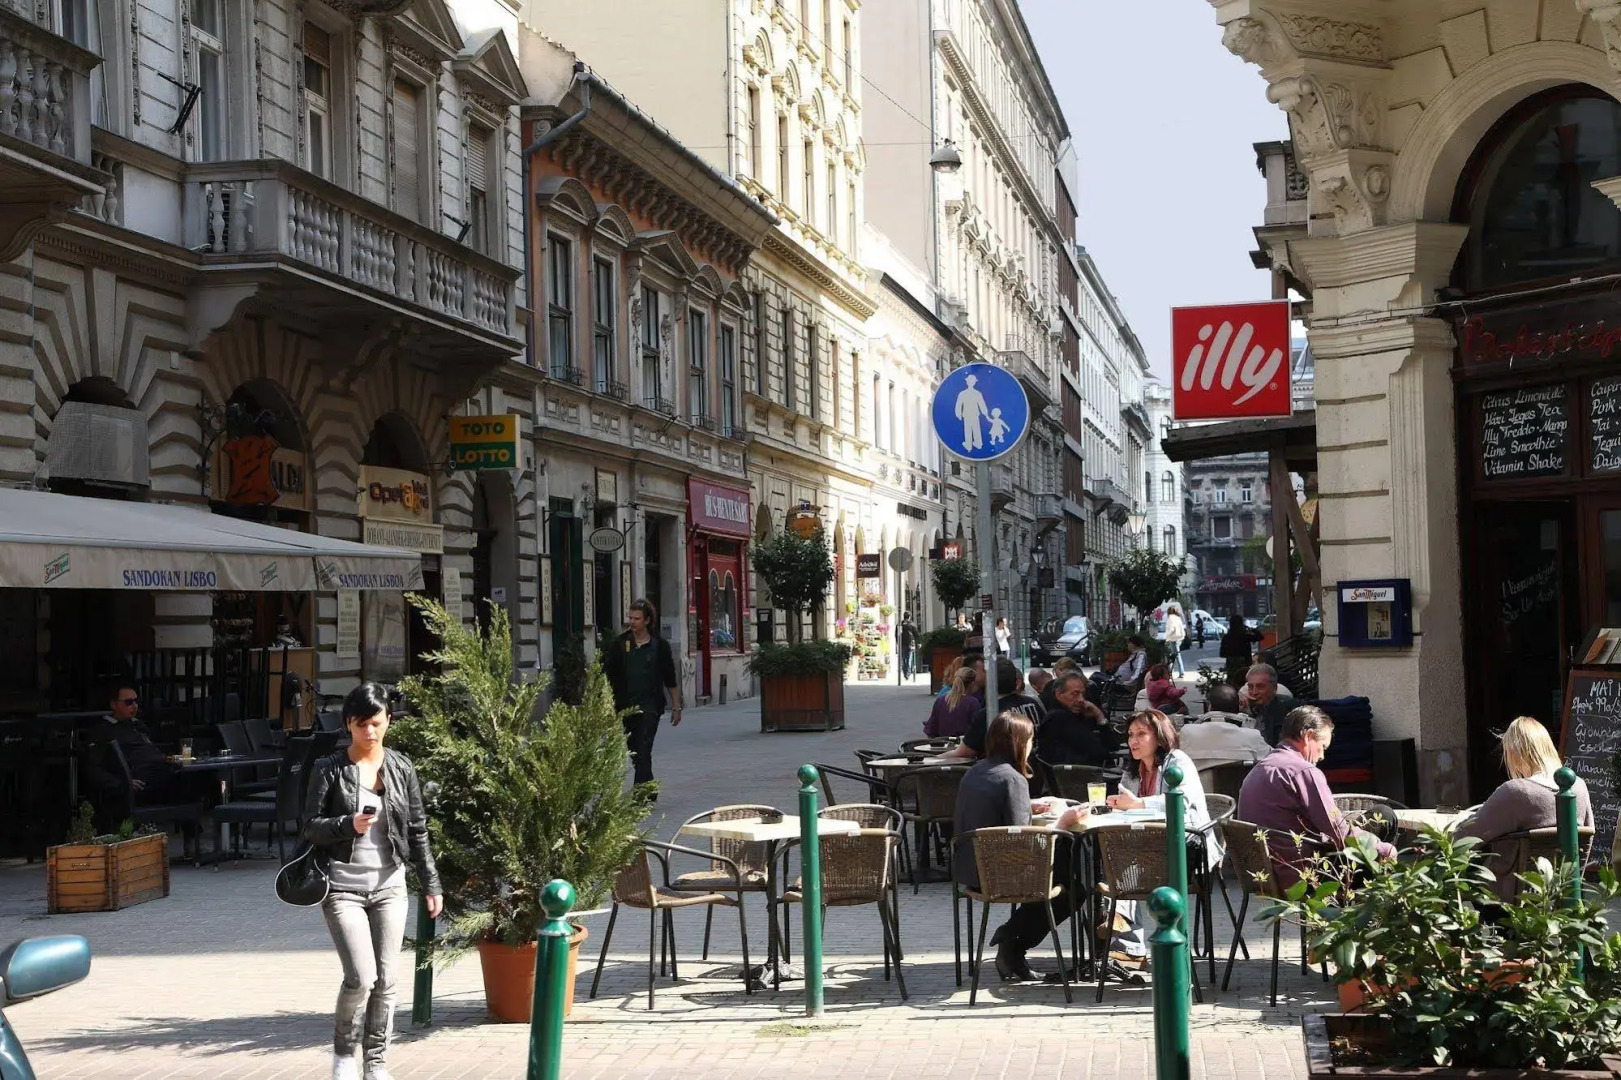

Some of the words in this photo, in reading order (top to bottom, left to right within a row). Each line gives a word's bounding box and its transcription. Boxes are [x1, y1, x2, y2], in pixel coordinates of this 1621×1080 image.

[1180, 320, 1284, 406] illy
[1537, 402, 1563, 418] Tea
[462, 422, 505, 436] TOTO
[455, 448, 510, 463] LOTTO
[1483, 444, 1506, 459] Lime
[1483, 459, 1524, 476] Vitamin
[1527, 452, 1564, 471] Shake
[123, 570, 182, 587] SANDOKAN
[338, 573, 379, 588] SANDOKAN
[379, 574, 404, 588] LISBOA
